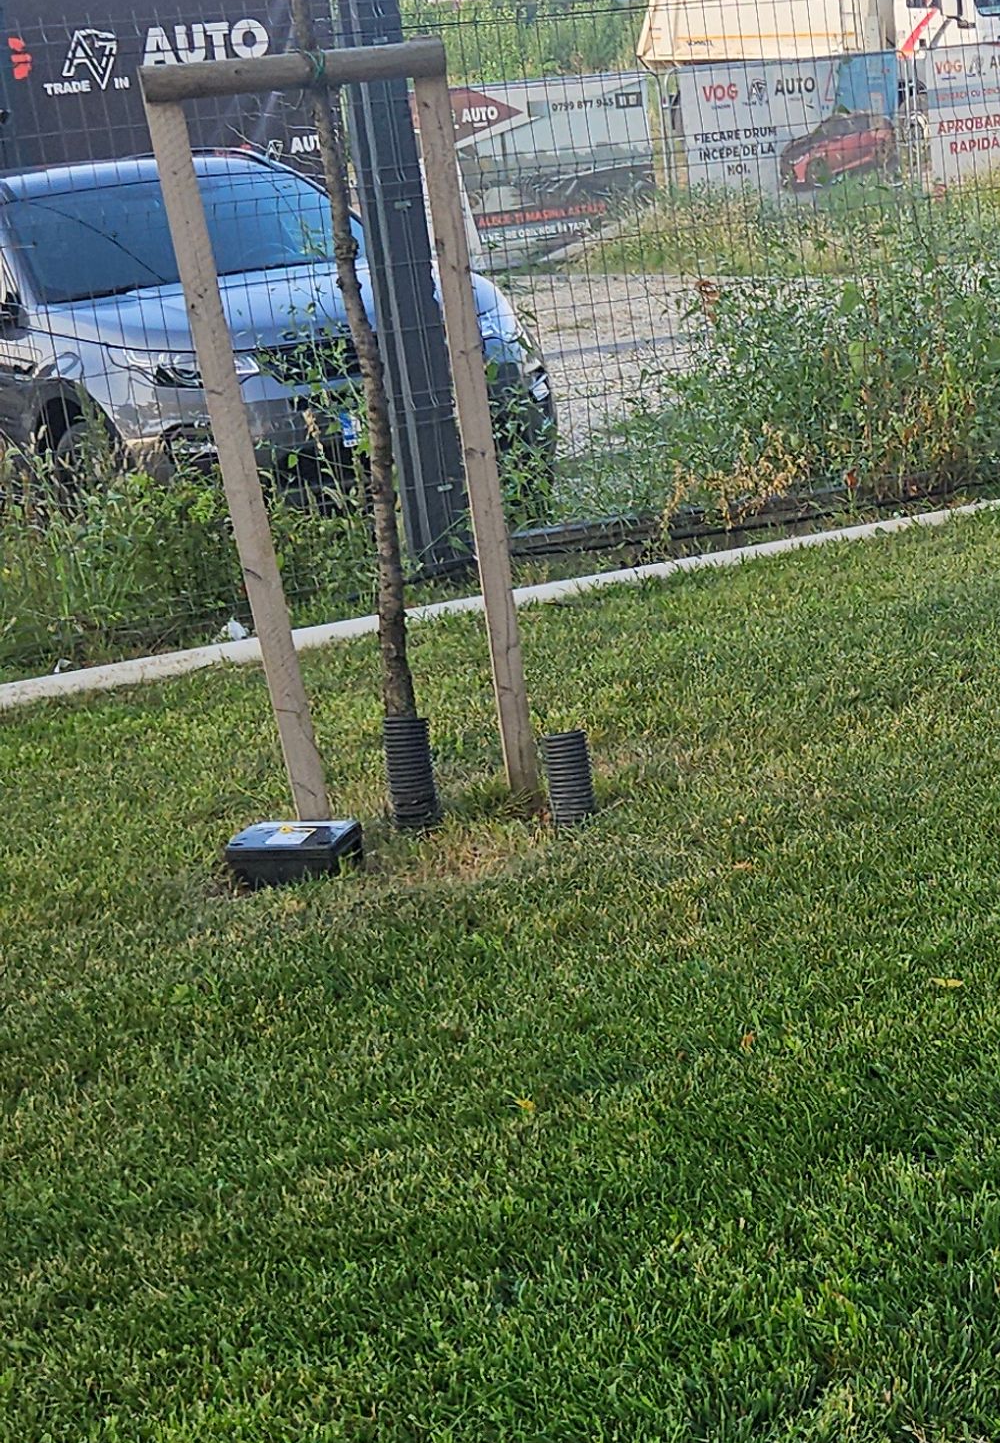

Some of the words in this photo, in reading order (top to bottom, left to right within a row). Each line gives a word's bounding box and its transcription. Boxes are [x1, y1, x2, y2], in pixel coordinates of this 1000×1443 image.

[143, 19, 269, 66] AUTO
[935, 59, 963, 75] VOG
[43, 80, 91, 96] TRADE
[113, 77, 131, 89] IN
[703, 83, 738, 102] VOG
[775, 77, 816, 97] AUTO
[462, 106, 499, 123] AUTO
[694, 129, 741, 144] FIECARE
[744, 126, 778, 140] DRUM
[950, 133, 1000, 154] RAPIDĂ
[743, 143, 758, 157] DE
[761, 142, 775, 155] LA
